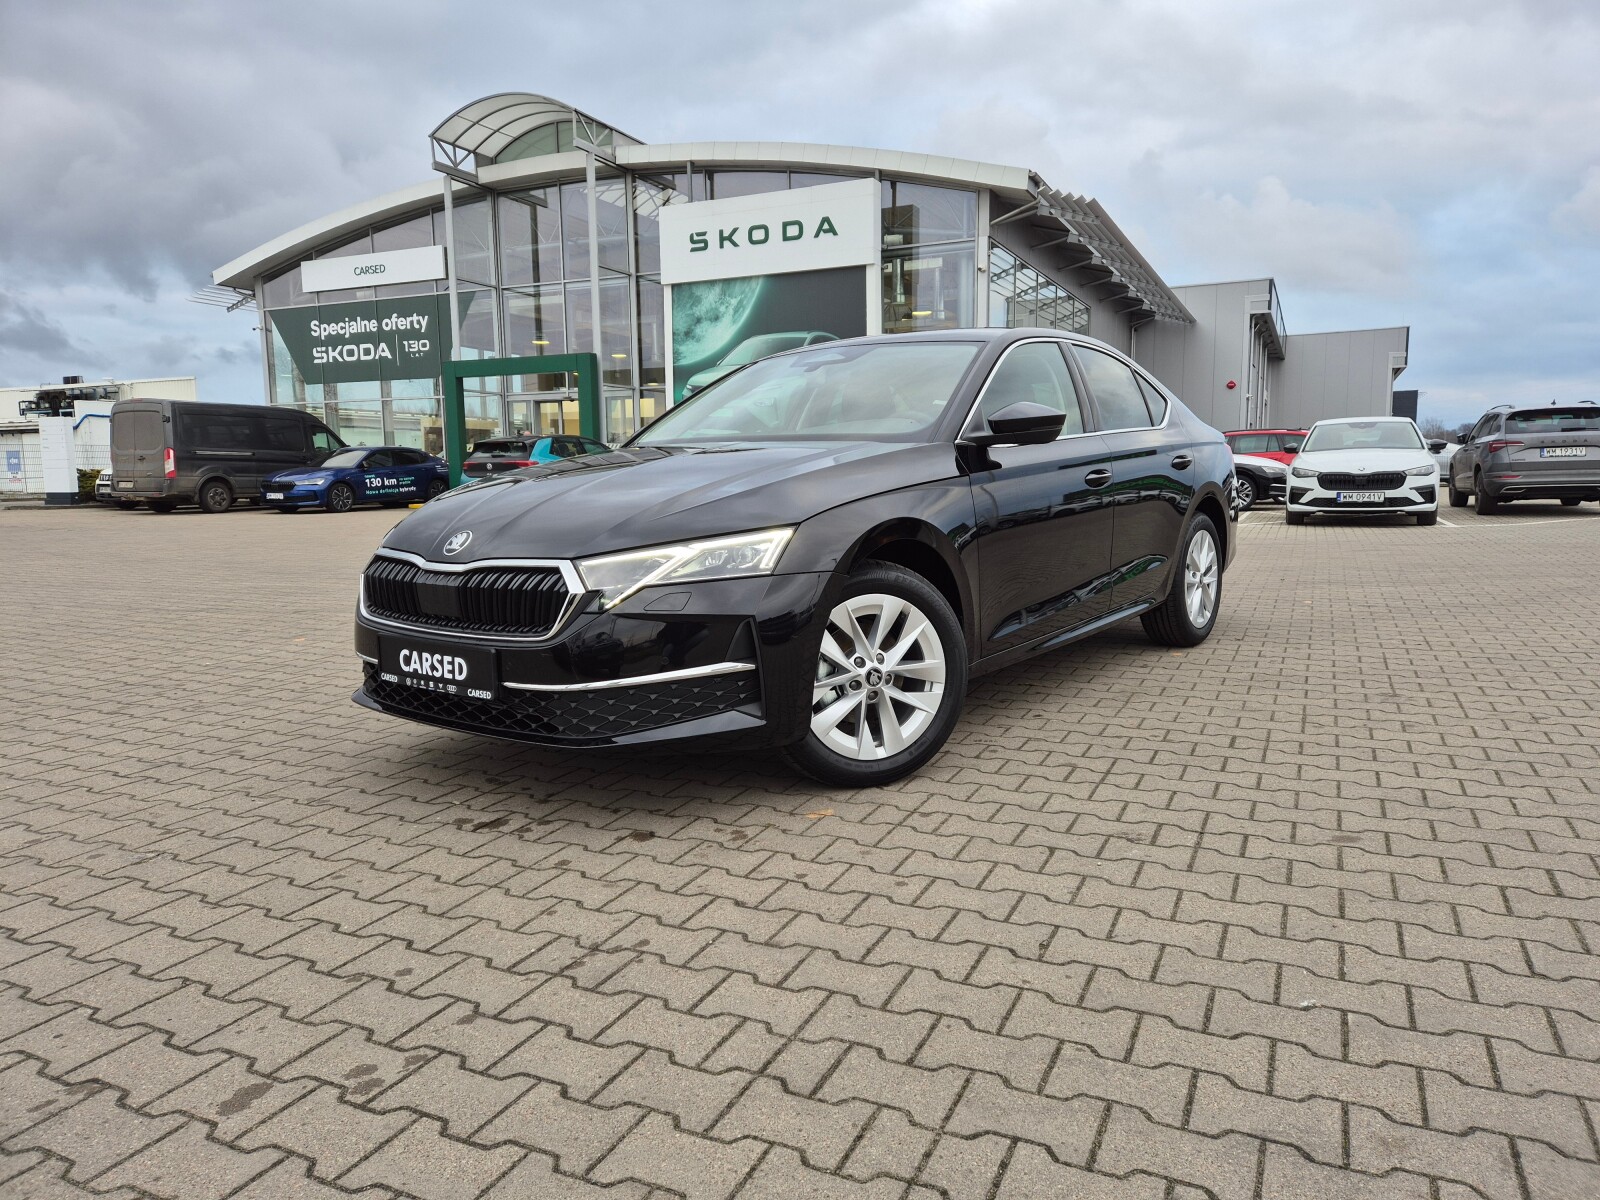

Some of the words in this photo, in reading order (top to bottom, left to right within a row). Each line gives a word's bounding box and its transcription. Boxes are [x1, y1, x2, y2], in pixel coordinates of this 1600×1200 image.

[353, 264, 386, 276] CARSED
[310, 316, 378, 340] Specjalne
[382, 312, 429, 333] oferty
[402, 339, 430, 352] 130
[1546, 447, 1557, 455] WM
[1559, 447, 1584, 455] 1931V
[365, 478, 382, 487] 130
[384, 477, 397, 486] km
[1342, 493, 1354, 501] WM
[1355, 493, 1383, 501] 0941V
[399, 648, 468, 681] CARSED
[380, 672, 398, 683] CARSED
[467, 688, 492, 699] CARSED
